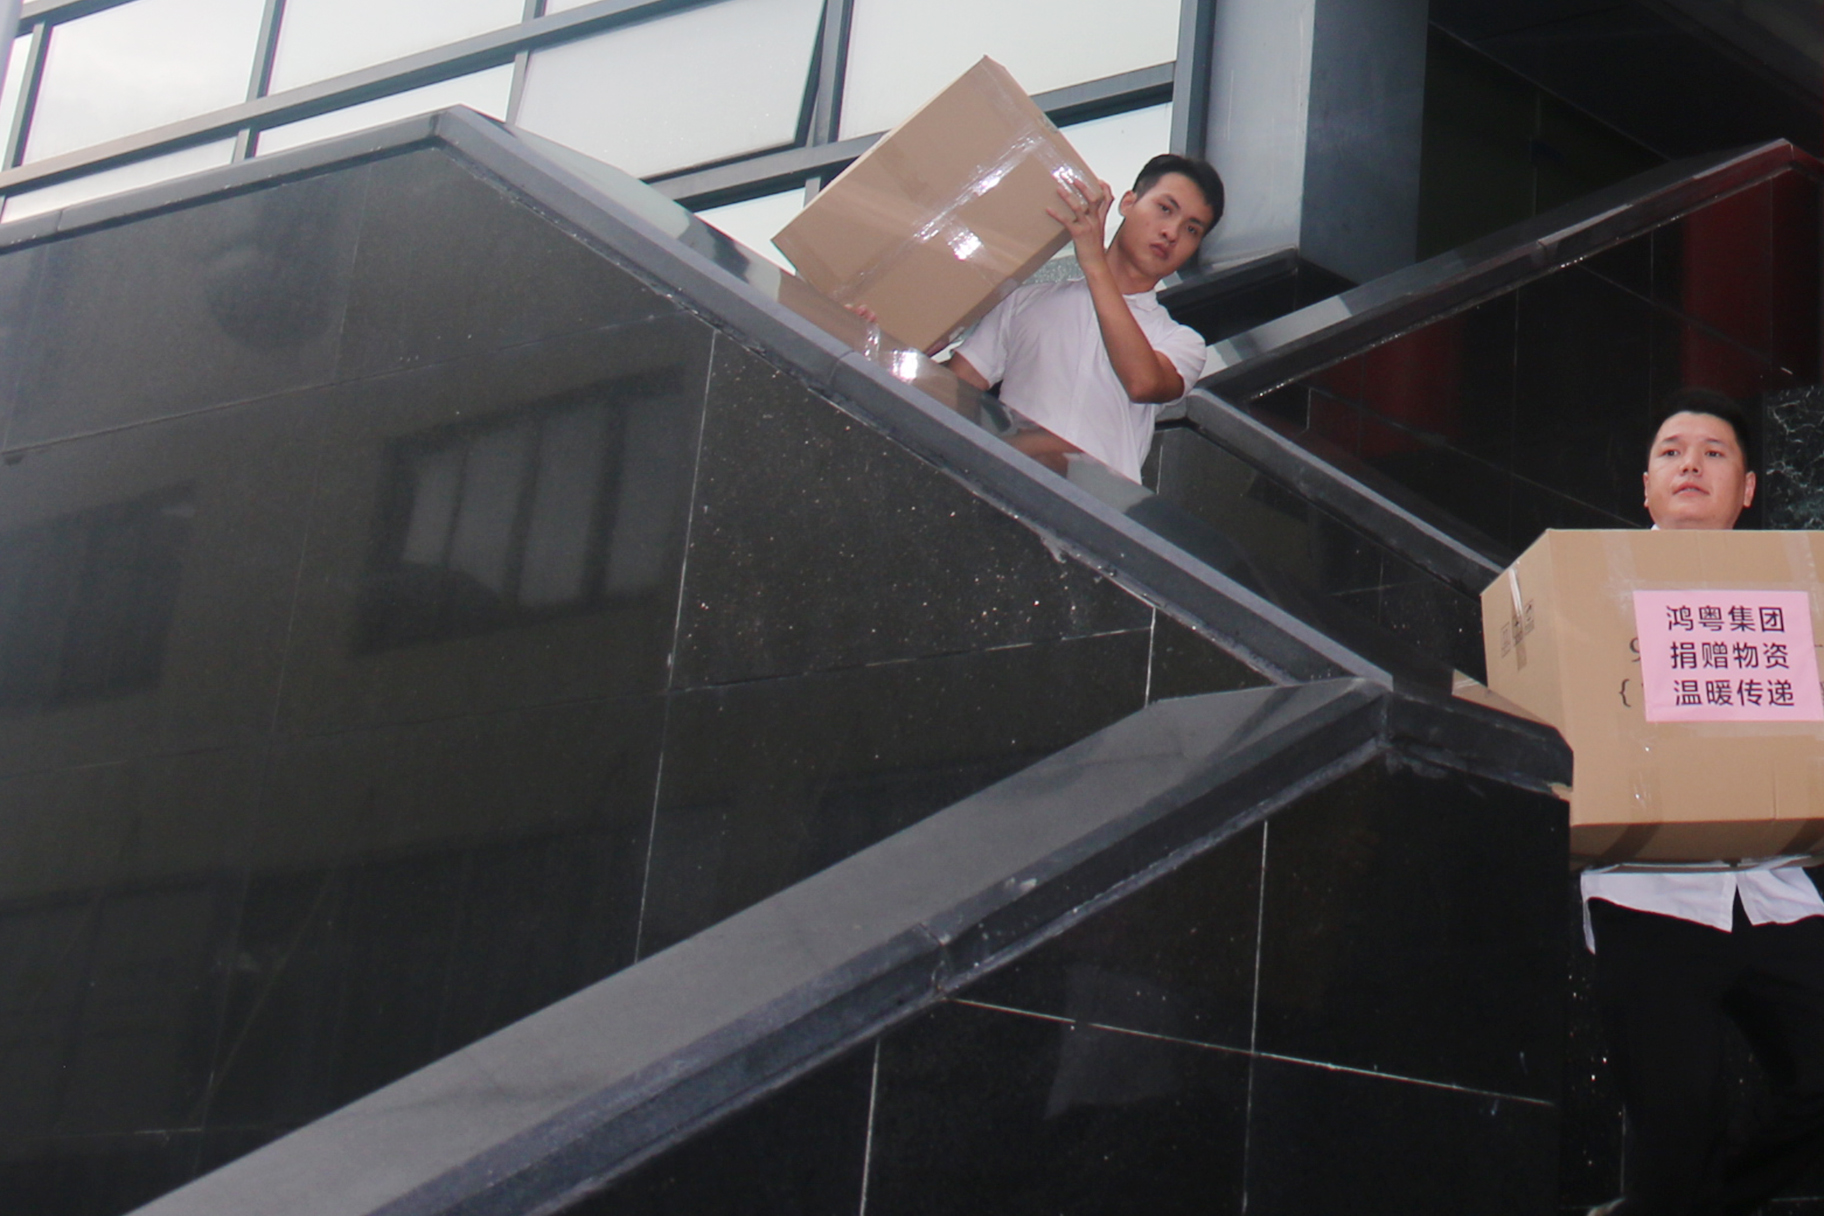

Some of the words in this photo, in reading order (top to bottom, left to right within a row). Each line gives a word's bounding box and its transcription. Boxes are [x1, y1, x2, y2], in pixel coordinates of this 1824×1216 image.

[1666, 605, 1786, 633] 鸿粤集团
[1670, 641, 1790, 670] 捐赠物资
[1673, 679, 1795, 707] 温暖传递
